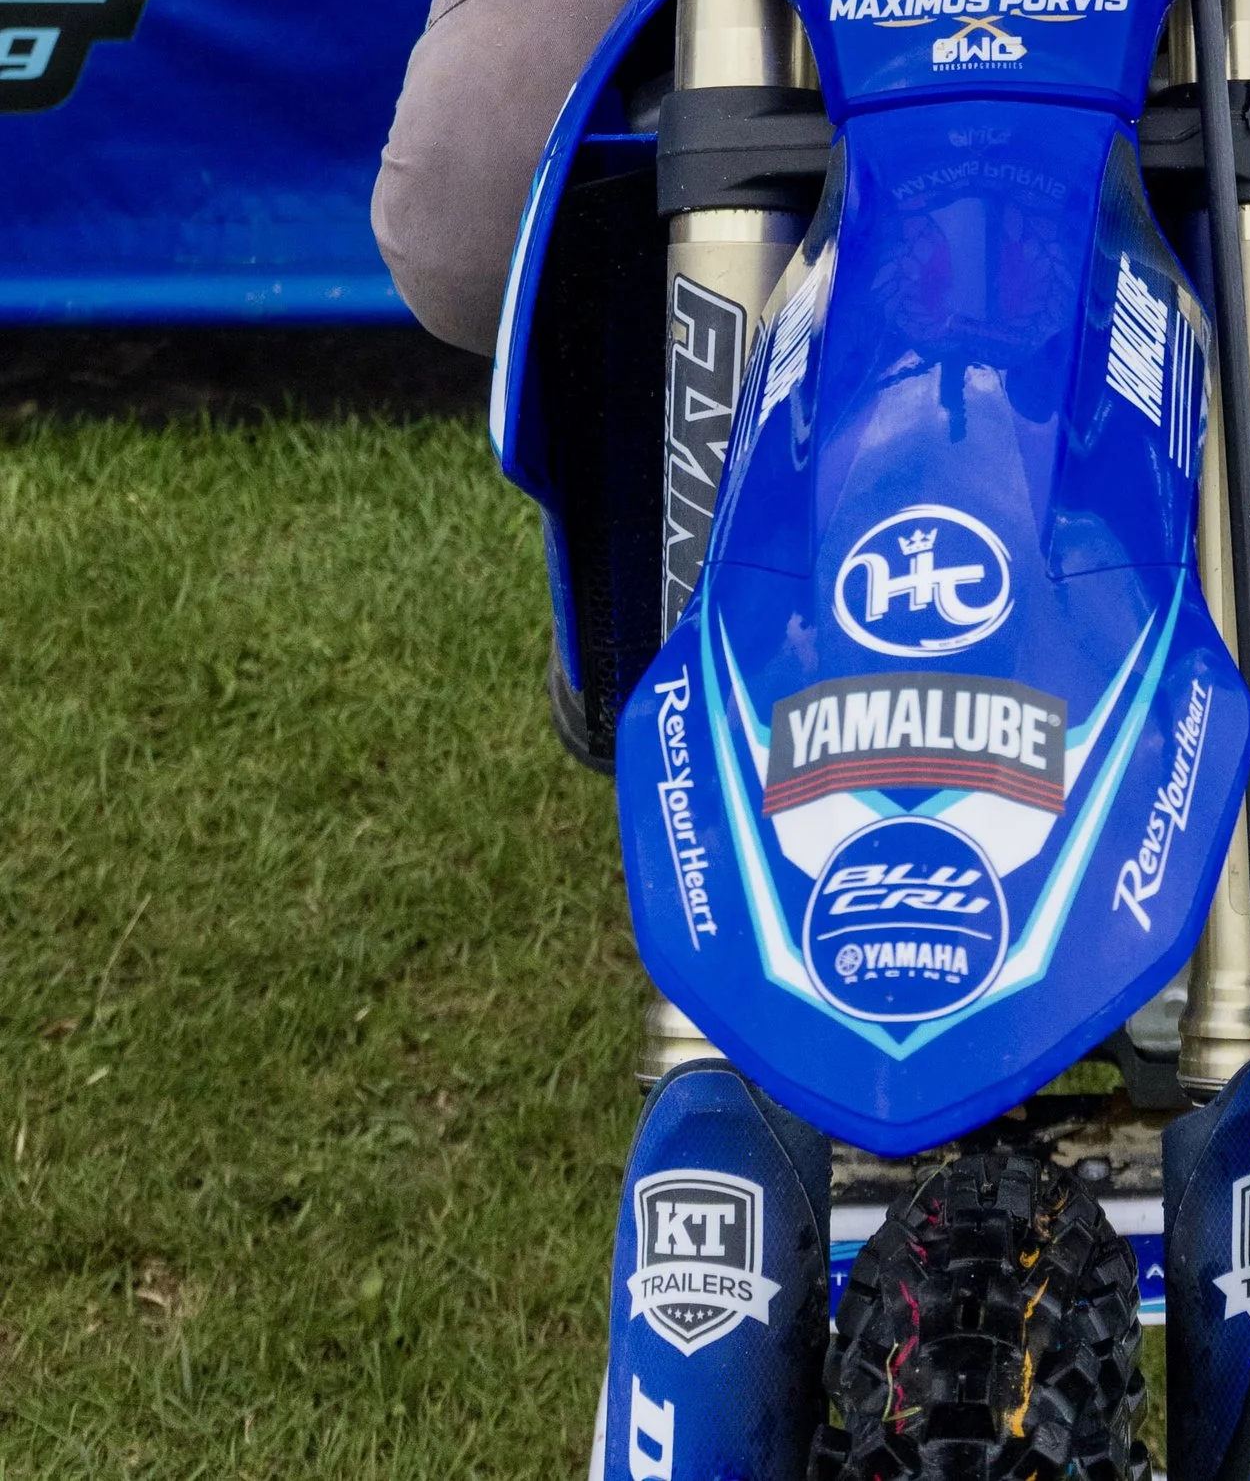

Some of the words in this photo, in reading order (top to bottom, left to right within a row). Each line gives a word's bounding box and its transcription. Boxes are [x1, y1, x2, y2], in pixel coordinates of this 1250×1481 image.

[1106, 251, 1168, 427] YAMALUBE
[788, 688, 1048, 770] YAMALUBE
[823, 863, 982, 894] BLU
[828, 888, 991, 915] CRU
[863, 941, 969, 975] YAMAHA
[844, 969, 962, 985] RACING
[654, 1201, 735, 1256] KT
[641, 1272, 754, 1302] TRAILERS
